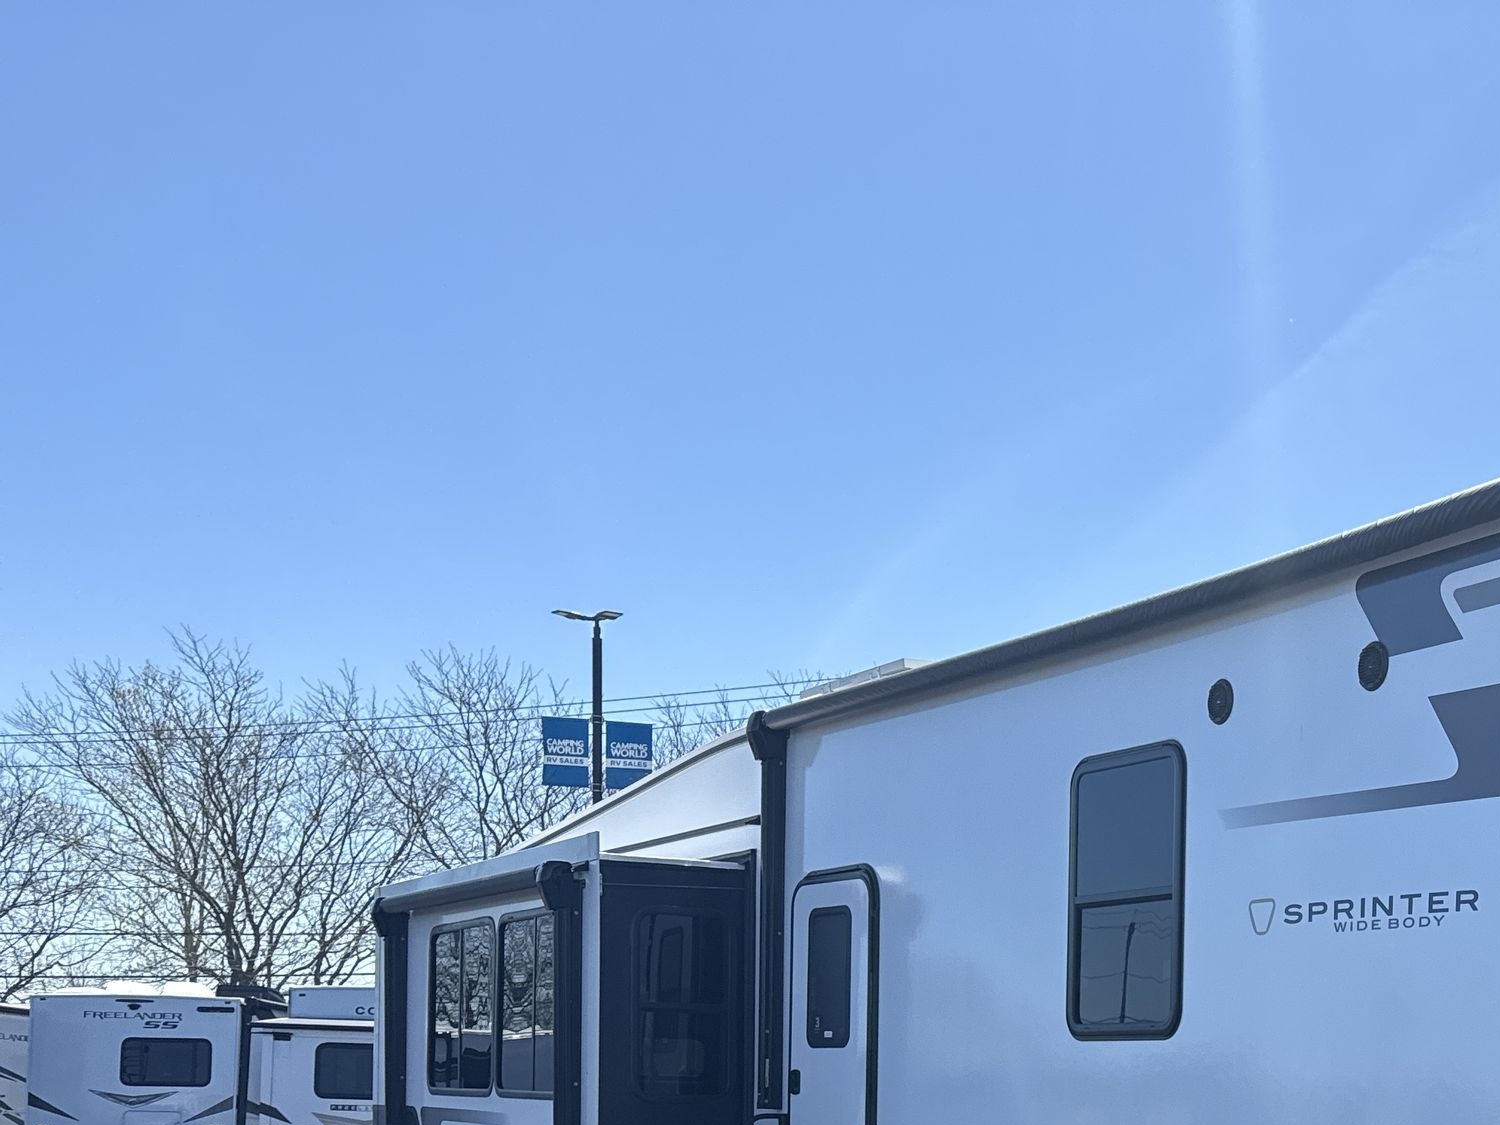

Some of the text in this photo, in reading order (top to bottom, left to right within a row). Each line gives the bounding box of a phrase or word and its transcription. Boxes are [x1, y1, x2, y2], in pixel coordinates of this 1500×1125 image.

[546, 738, 585, 748] CAMPING
[610, 741, 648, 750] CAMPING
[546, 745, 585, 755] WORLD
[611, 749, 648, 759] WORLD
[546, 756, 584, 765] RV SALES
[1283, 889, 1480, 925] SPRINTER
[1333, 914, 1446, 933] WIDE BODY
[83, 1010, 183, 1022] FREELANDER
[143, 1021, 180, 1030] SS
